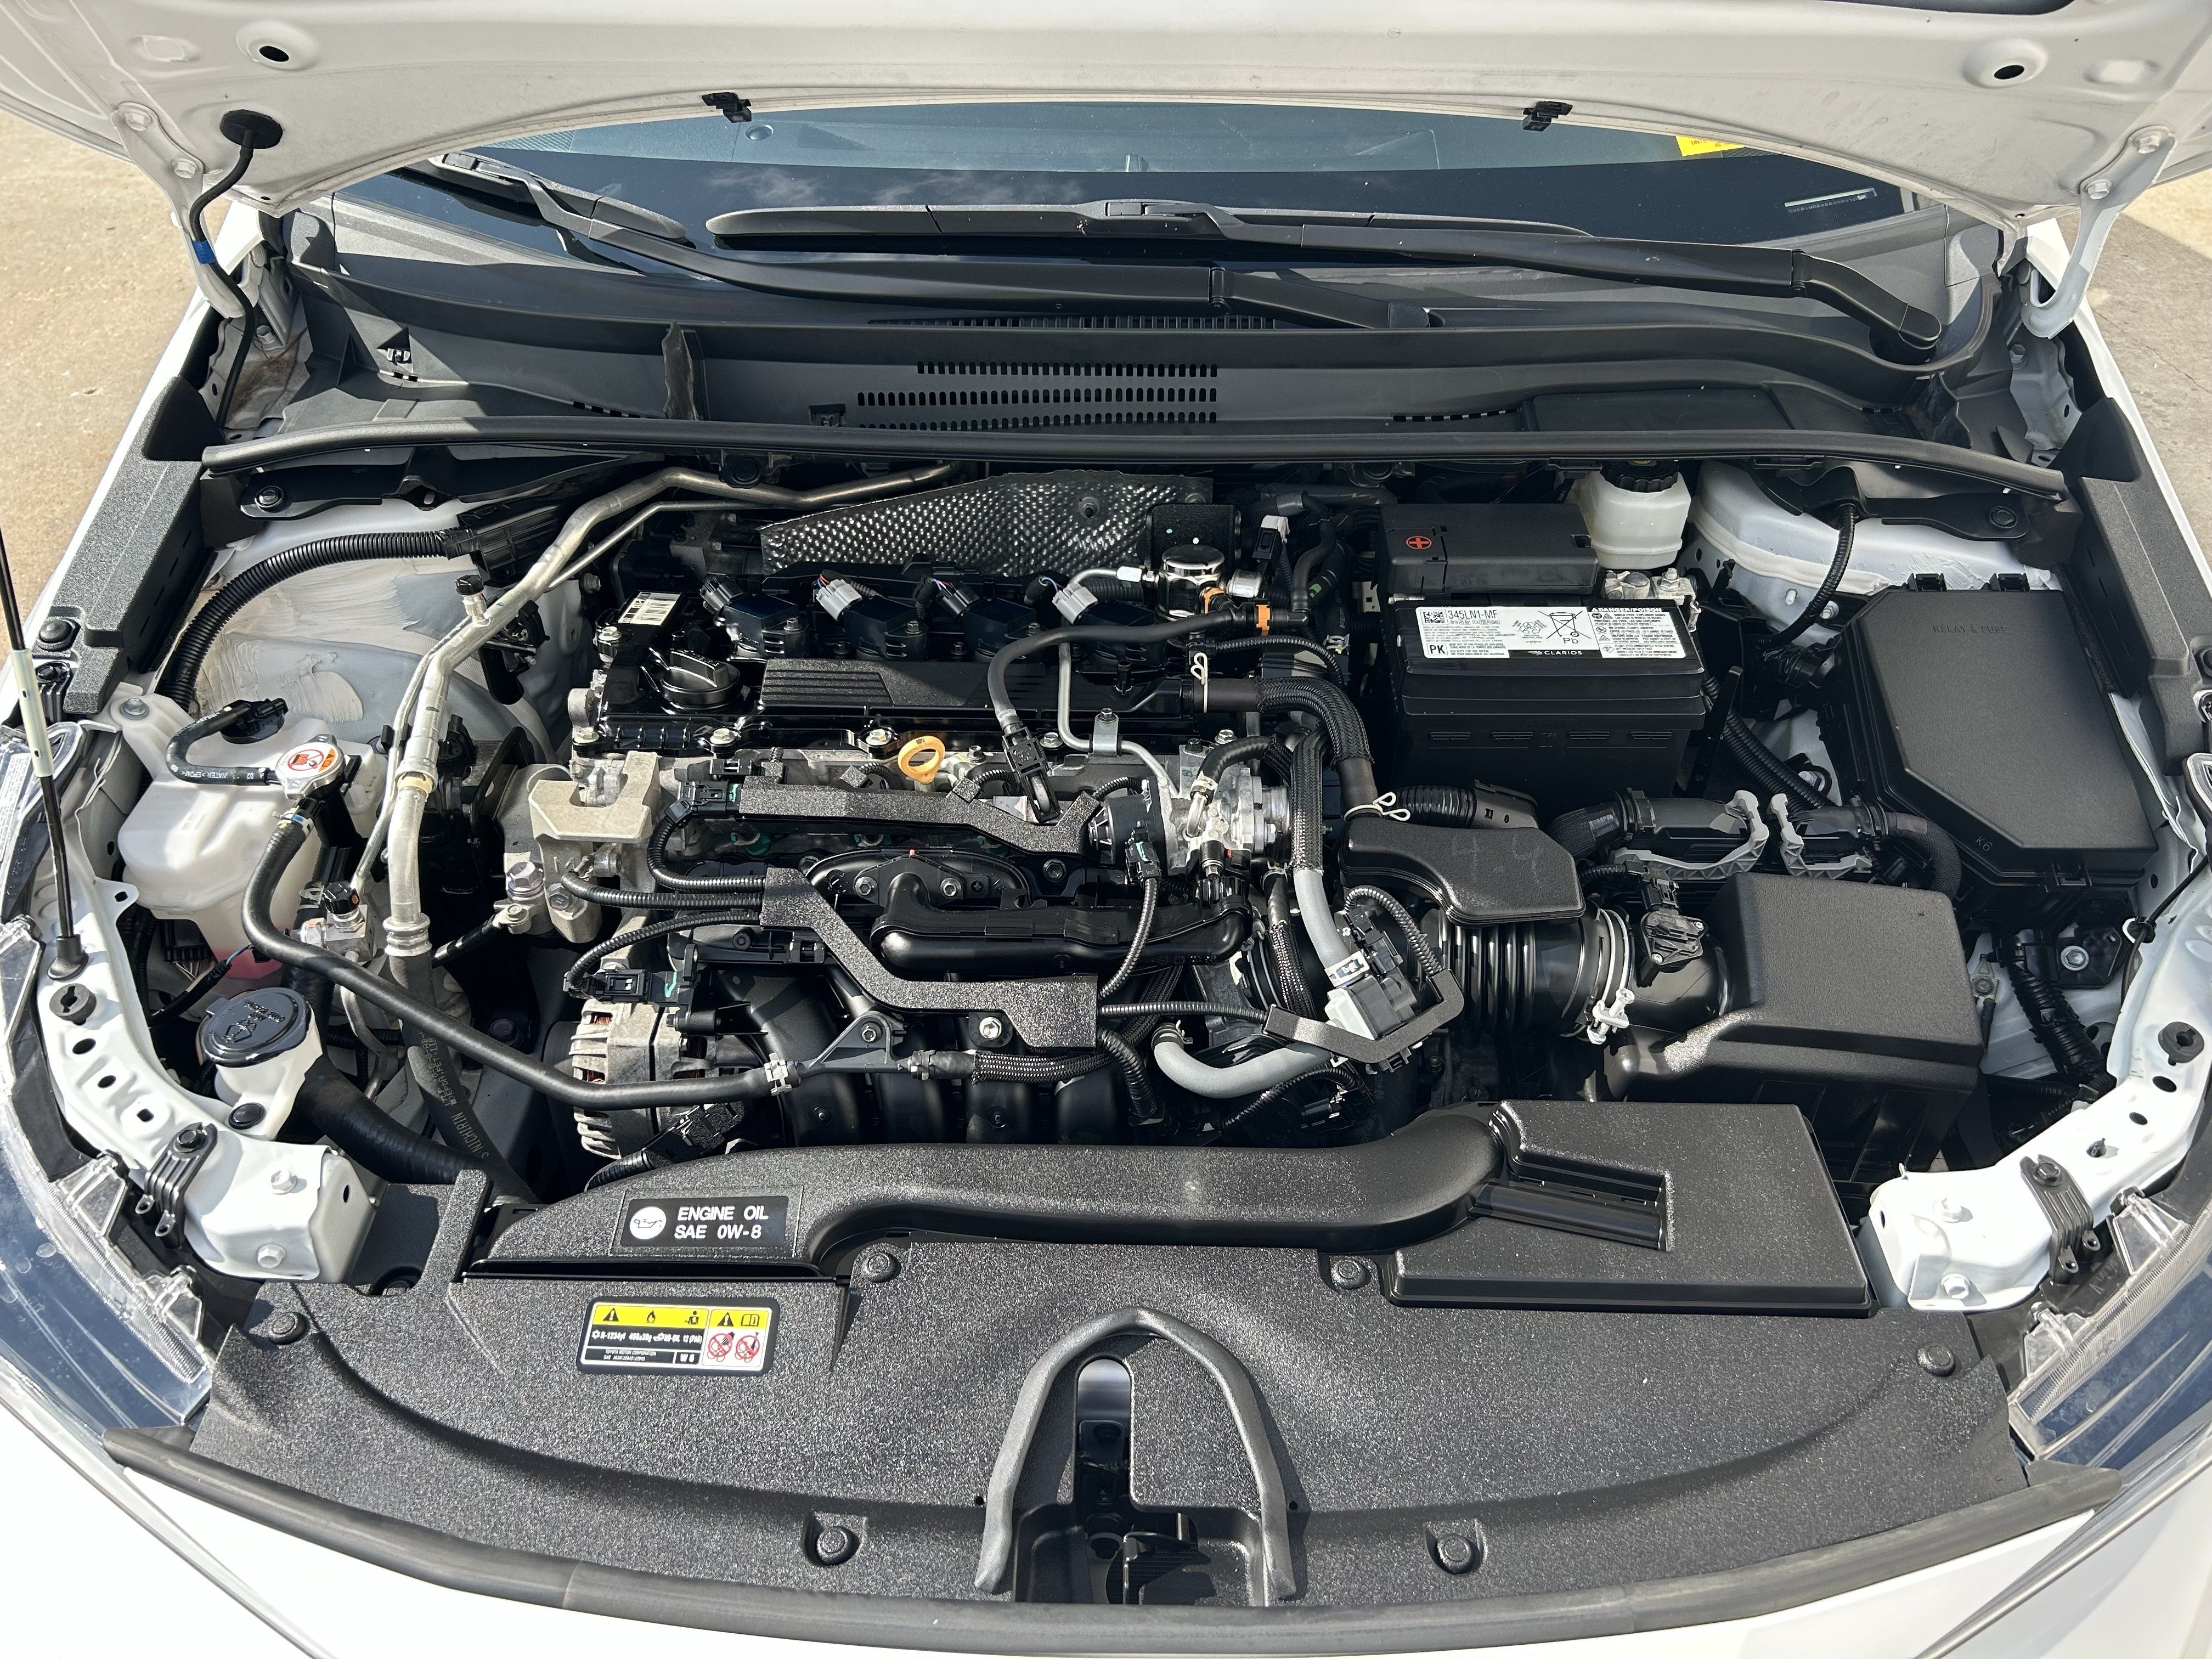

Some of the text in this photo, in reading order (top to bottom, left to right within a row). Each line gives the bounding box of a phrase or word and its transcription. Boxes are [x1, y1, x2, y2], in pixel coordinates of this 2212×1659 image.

[1447, 610, 1498, 619] 345LN1-MF
[1429, 645, 1446, 654] PK
[1975, 836, 1993, 851] K6
[450, 1112, 484, 1153] NICHIRIN
[678, 1205, 769, 1221] ENGINE OIL
[674, 1224, 762, 1239] SAE 0W-8
